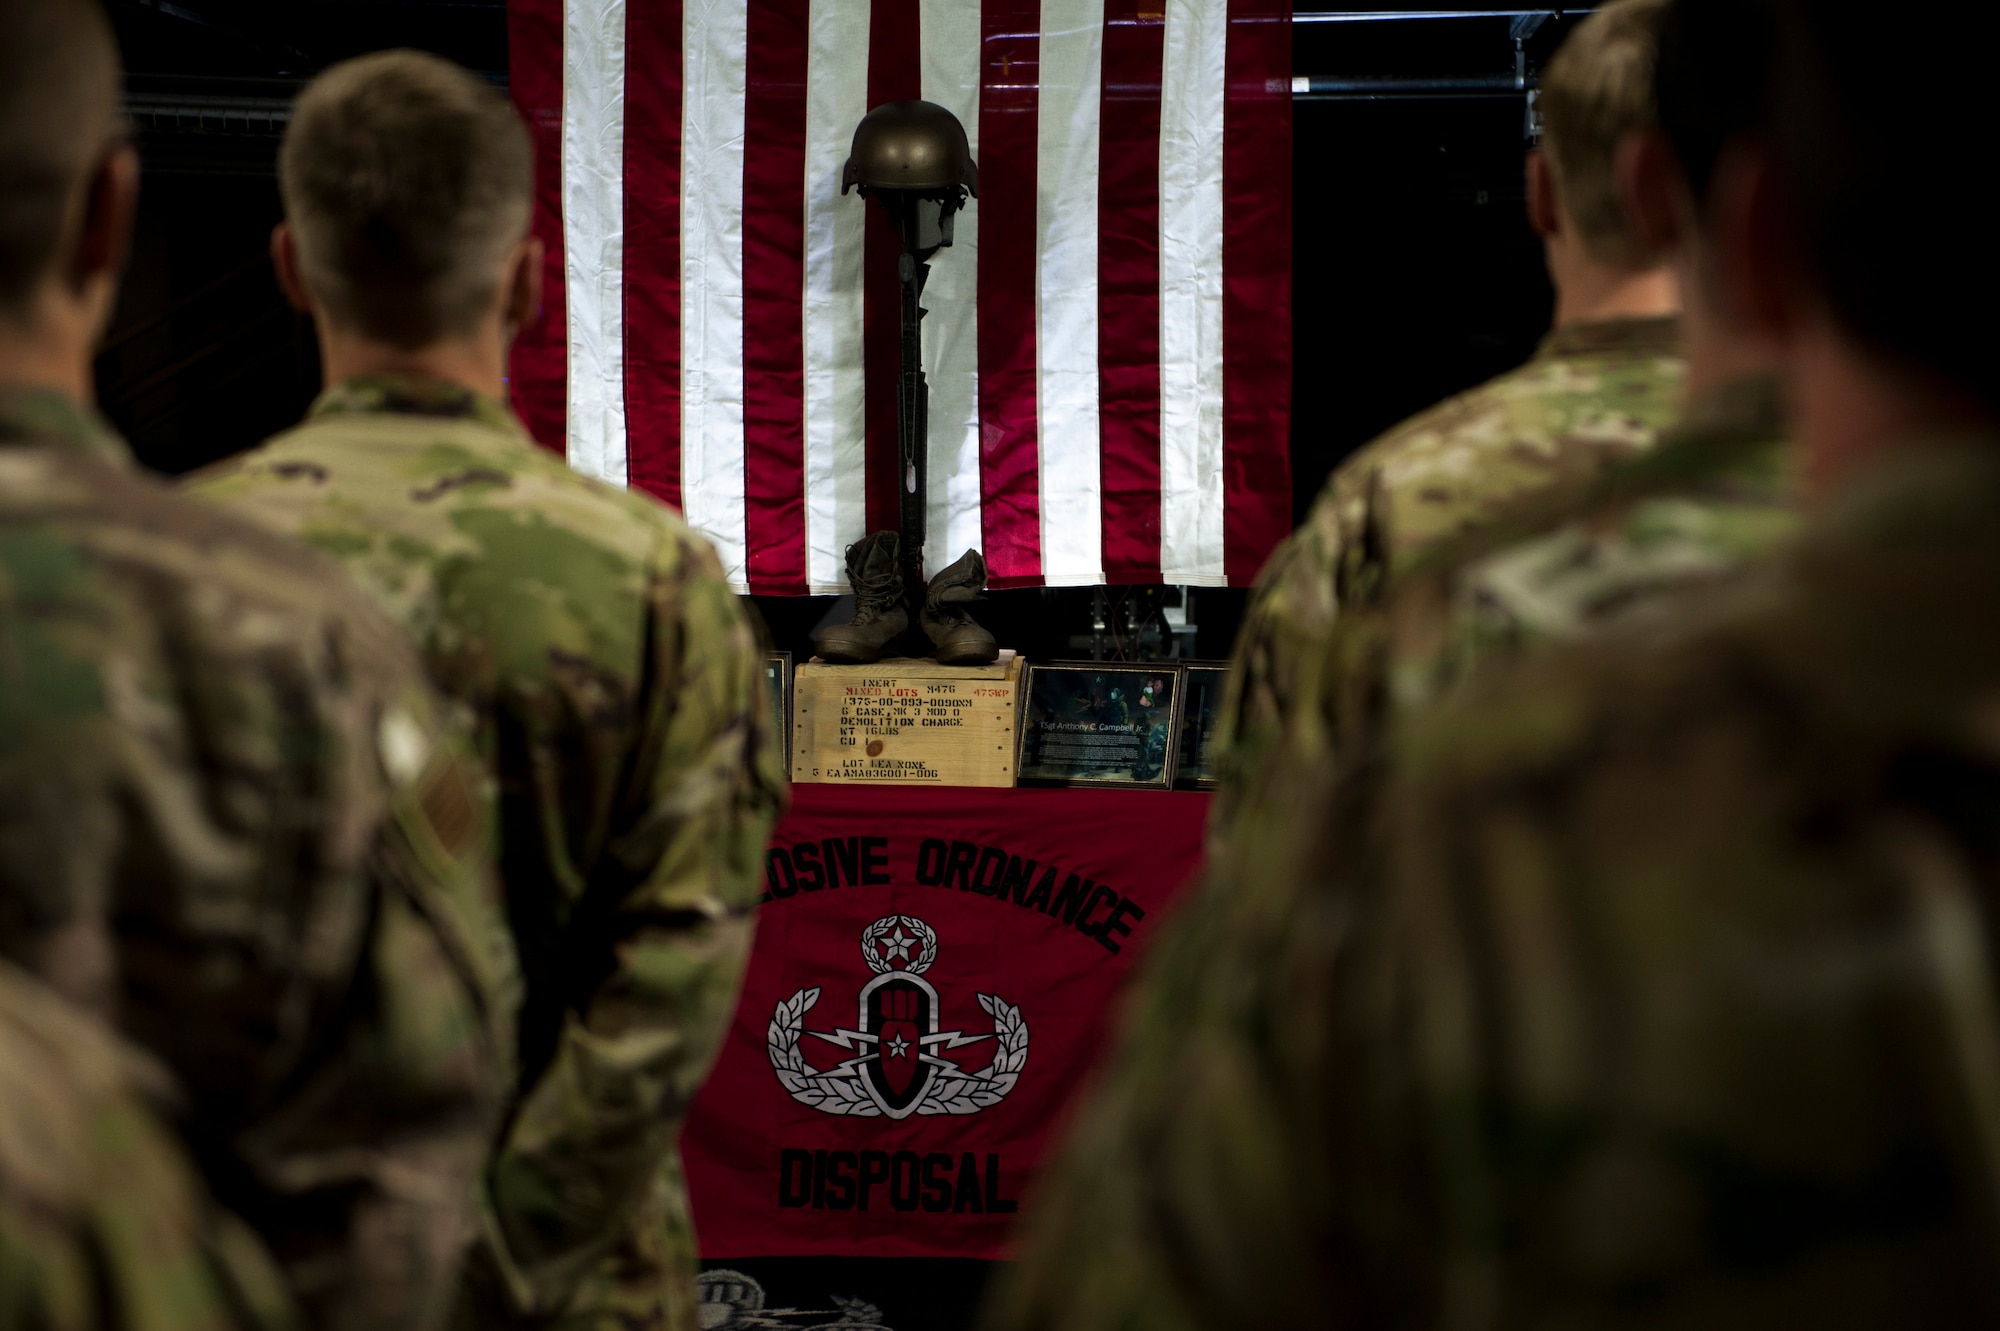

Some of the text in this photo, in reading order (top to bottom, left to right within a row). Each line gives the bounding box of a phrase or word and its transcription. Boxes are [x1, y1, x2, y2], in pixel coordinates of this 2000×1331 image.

[863, 679, 897, 688] INERT
[846, 687, 918, 697] MIXED LOTS
[927, 685, 956, 693] M476
[914, 708, 921, 716] 3
[926, 708, 947, 716] MOD
[840, 717, 963, 727] DEMOLITION CHARGE
[1039, 721, 1056, 731] TSgt
[1056, 722, 1088, 732] Anthony
[1098, 723, 1135, 733] Campbell
[840, 727, 855, 736] WT
[840, 737, 856, 746] CU
[843, 759, 864, 768] LOT
[897, 761, 926, 770] NONE
[761, 836, 1146, 955] OSIVE ORDNANCE
[778, 1148, 1019, 1214] DISPOSAL
